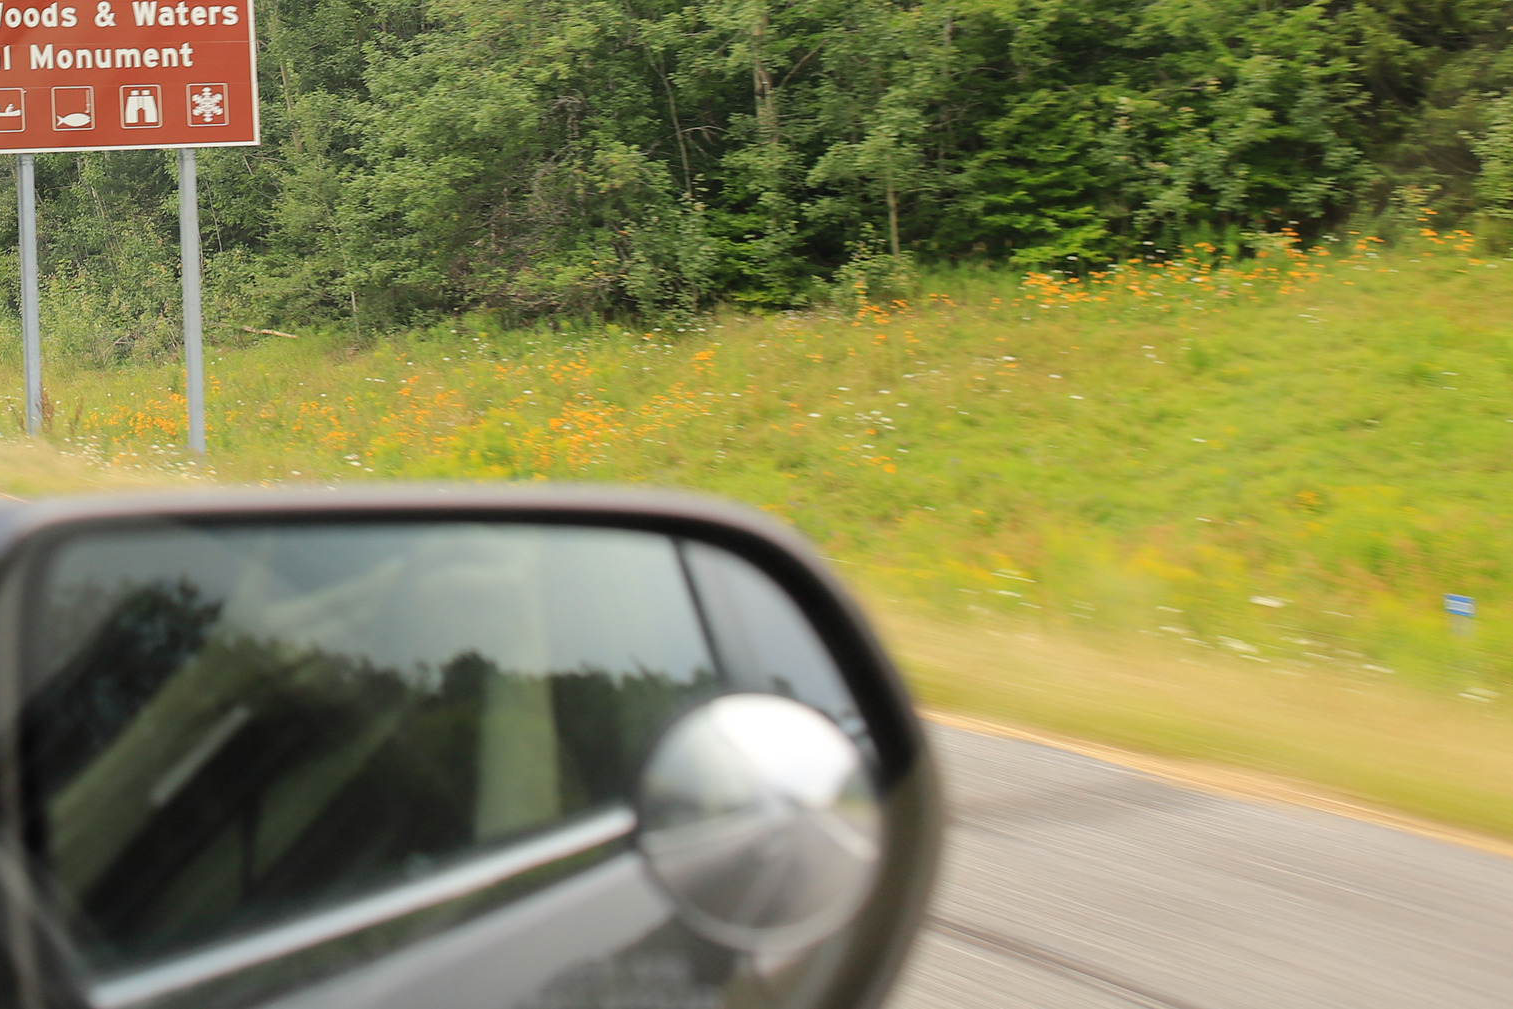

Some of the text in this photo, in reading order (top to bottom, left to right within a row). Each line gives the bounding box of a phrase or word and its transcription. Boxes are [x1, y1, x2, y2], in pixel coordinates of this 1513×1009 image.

[94, 0, 117, 28] &
[131, 0, 239, 27] Waters
[29, 42, 194, 70] Monument
